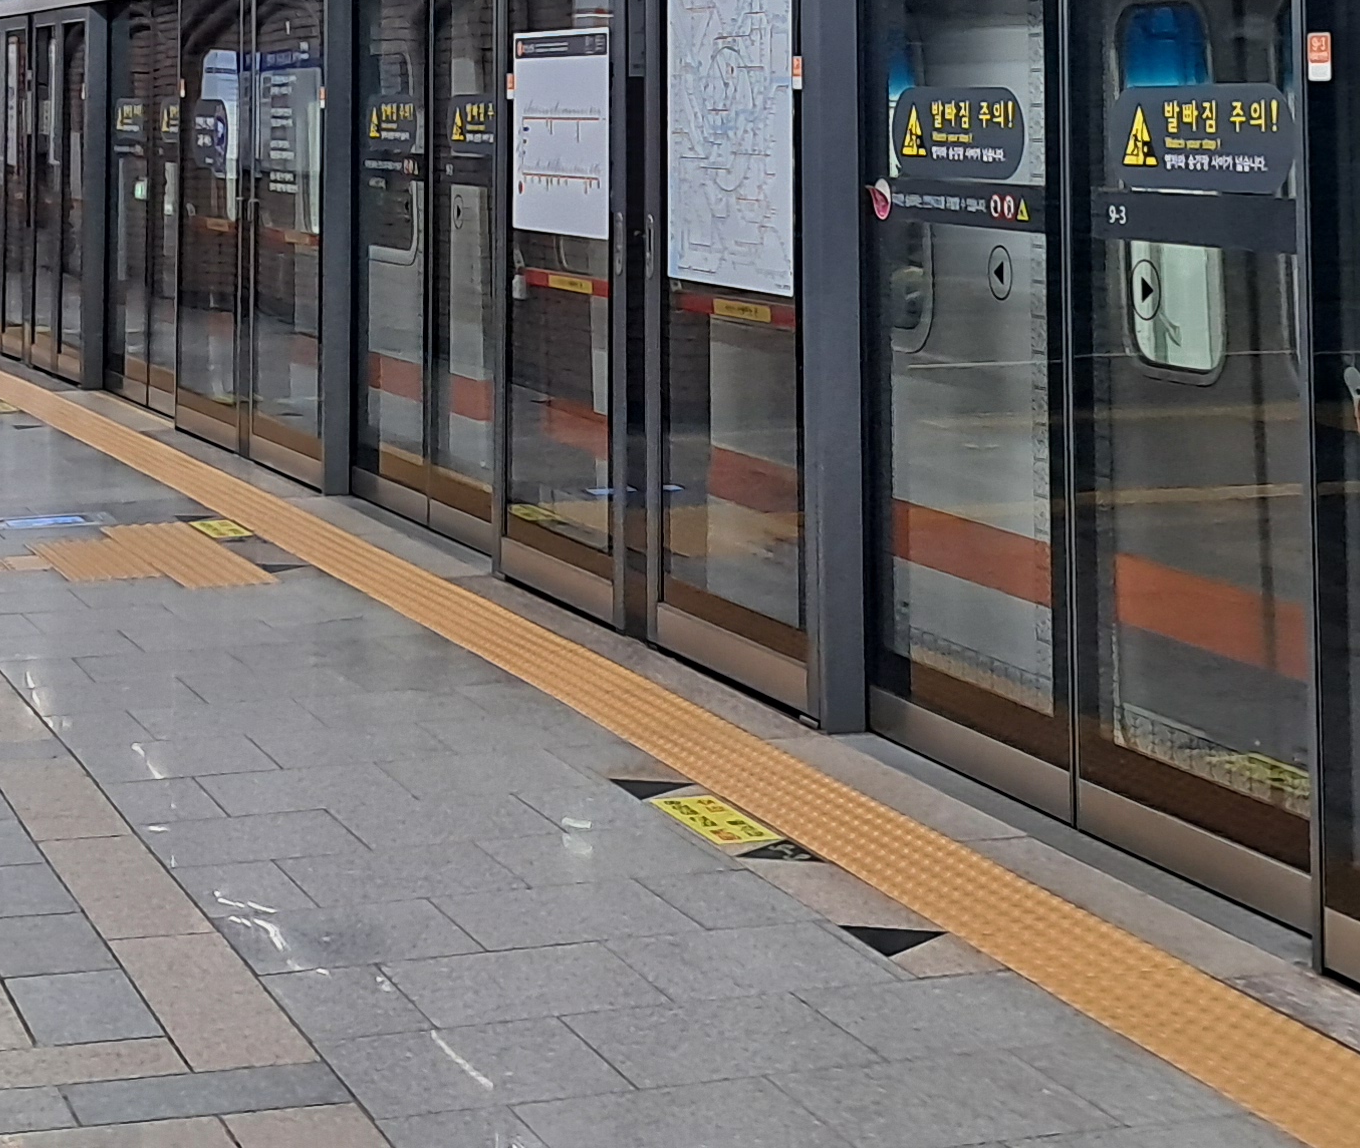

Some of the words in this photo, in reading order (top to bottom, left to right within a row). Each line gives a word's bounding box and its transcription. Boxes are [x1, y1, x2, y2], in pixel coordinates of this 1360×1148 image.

[979, 99, 1014, 129] 주의!
[1164, 100, 1217, 133] 발빠짐
[1229, 99, 1279, 133] 주의!
[1108, 205, 1127, 225] 9-3
